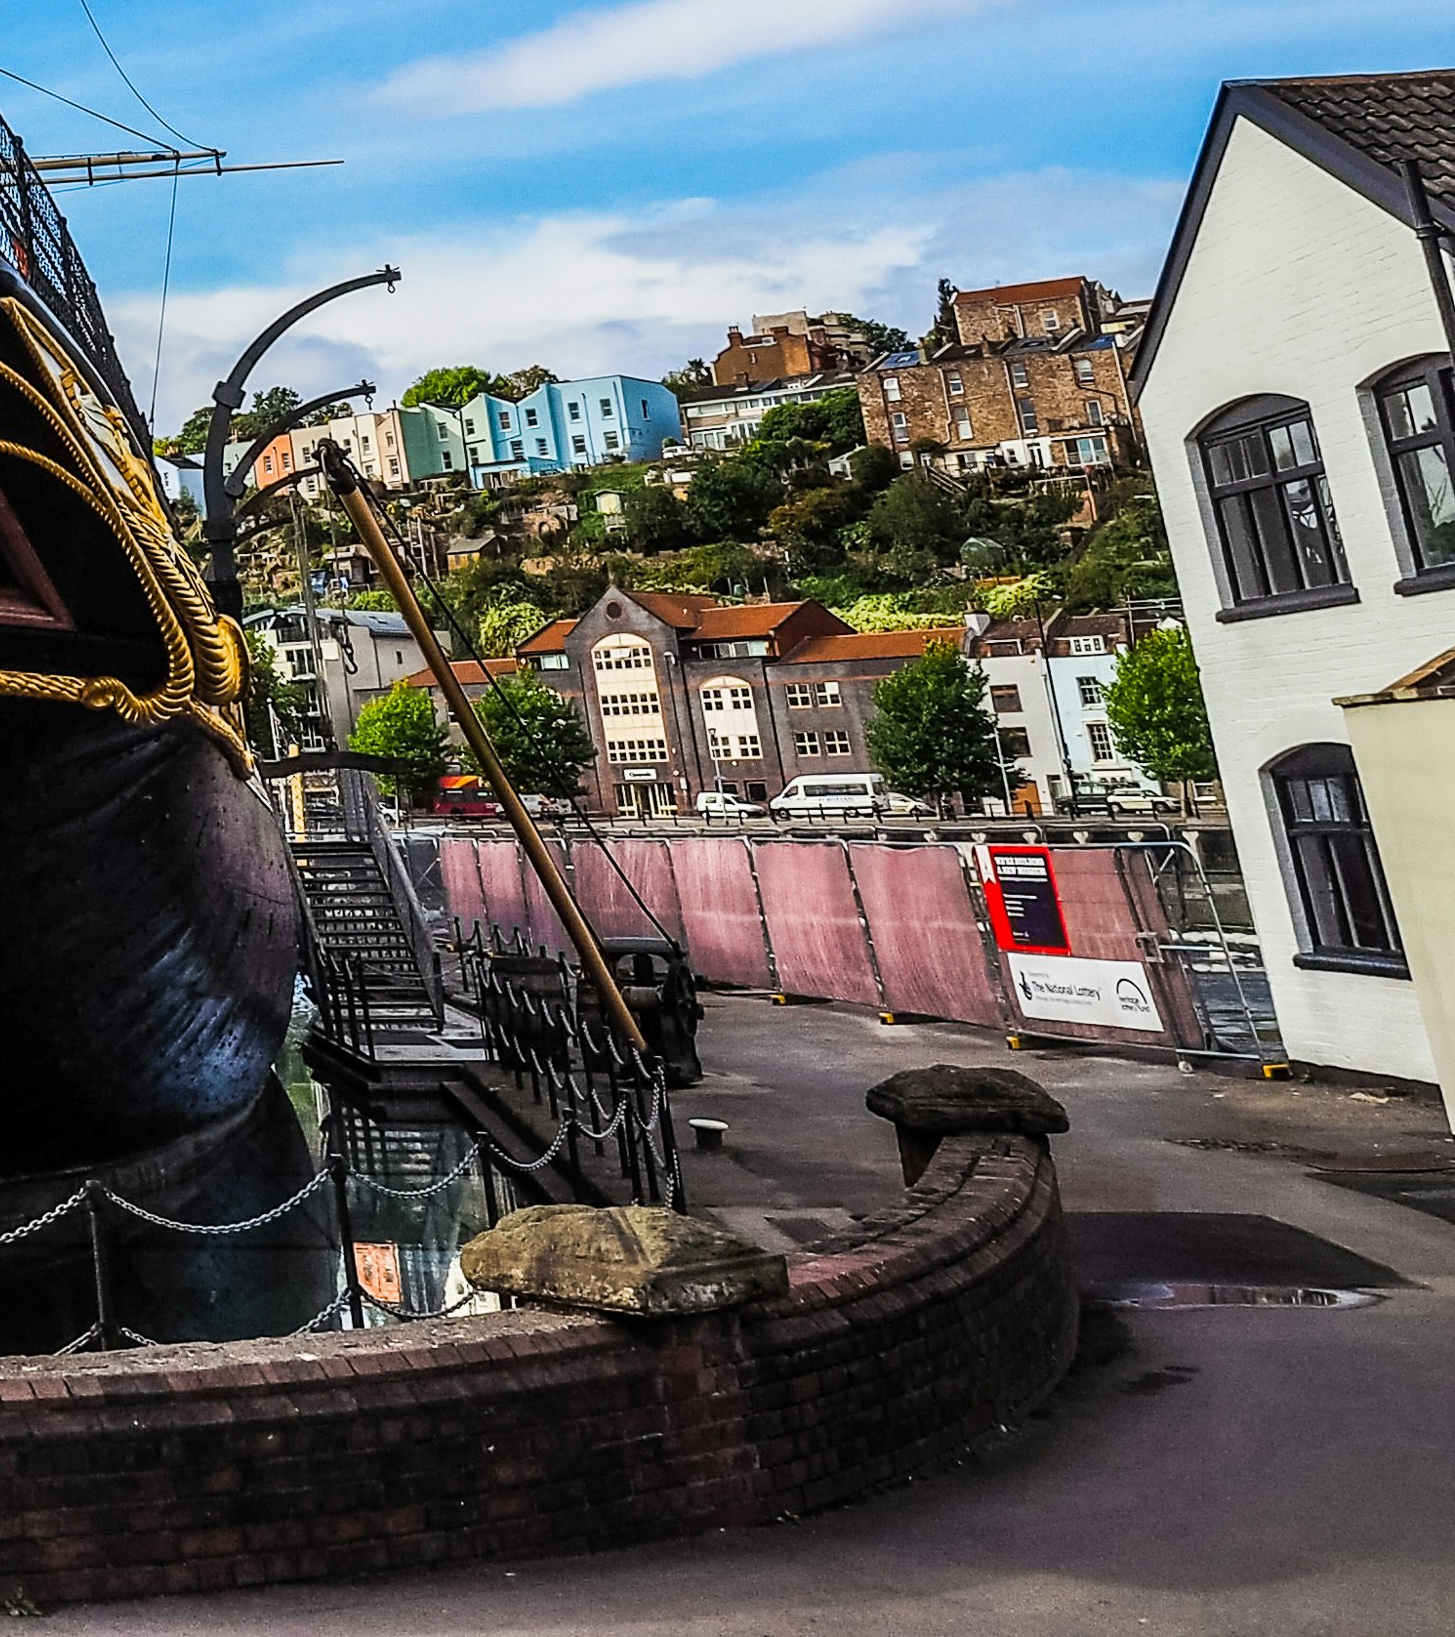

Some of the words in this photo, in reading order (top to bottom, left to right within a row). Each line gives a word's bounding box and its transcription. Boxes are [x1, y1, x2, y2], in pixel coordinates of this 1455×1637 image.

[1032, 981, 1045, 993] The
[1045, 982, 1073, 995] National
[1073, 985, 1101, 1001] Lottery
